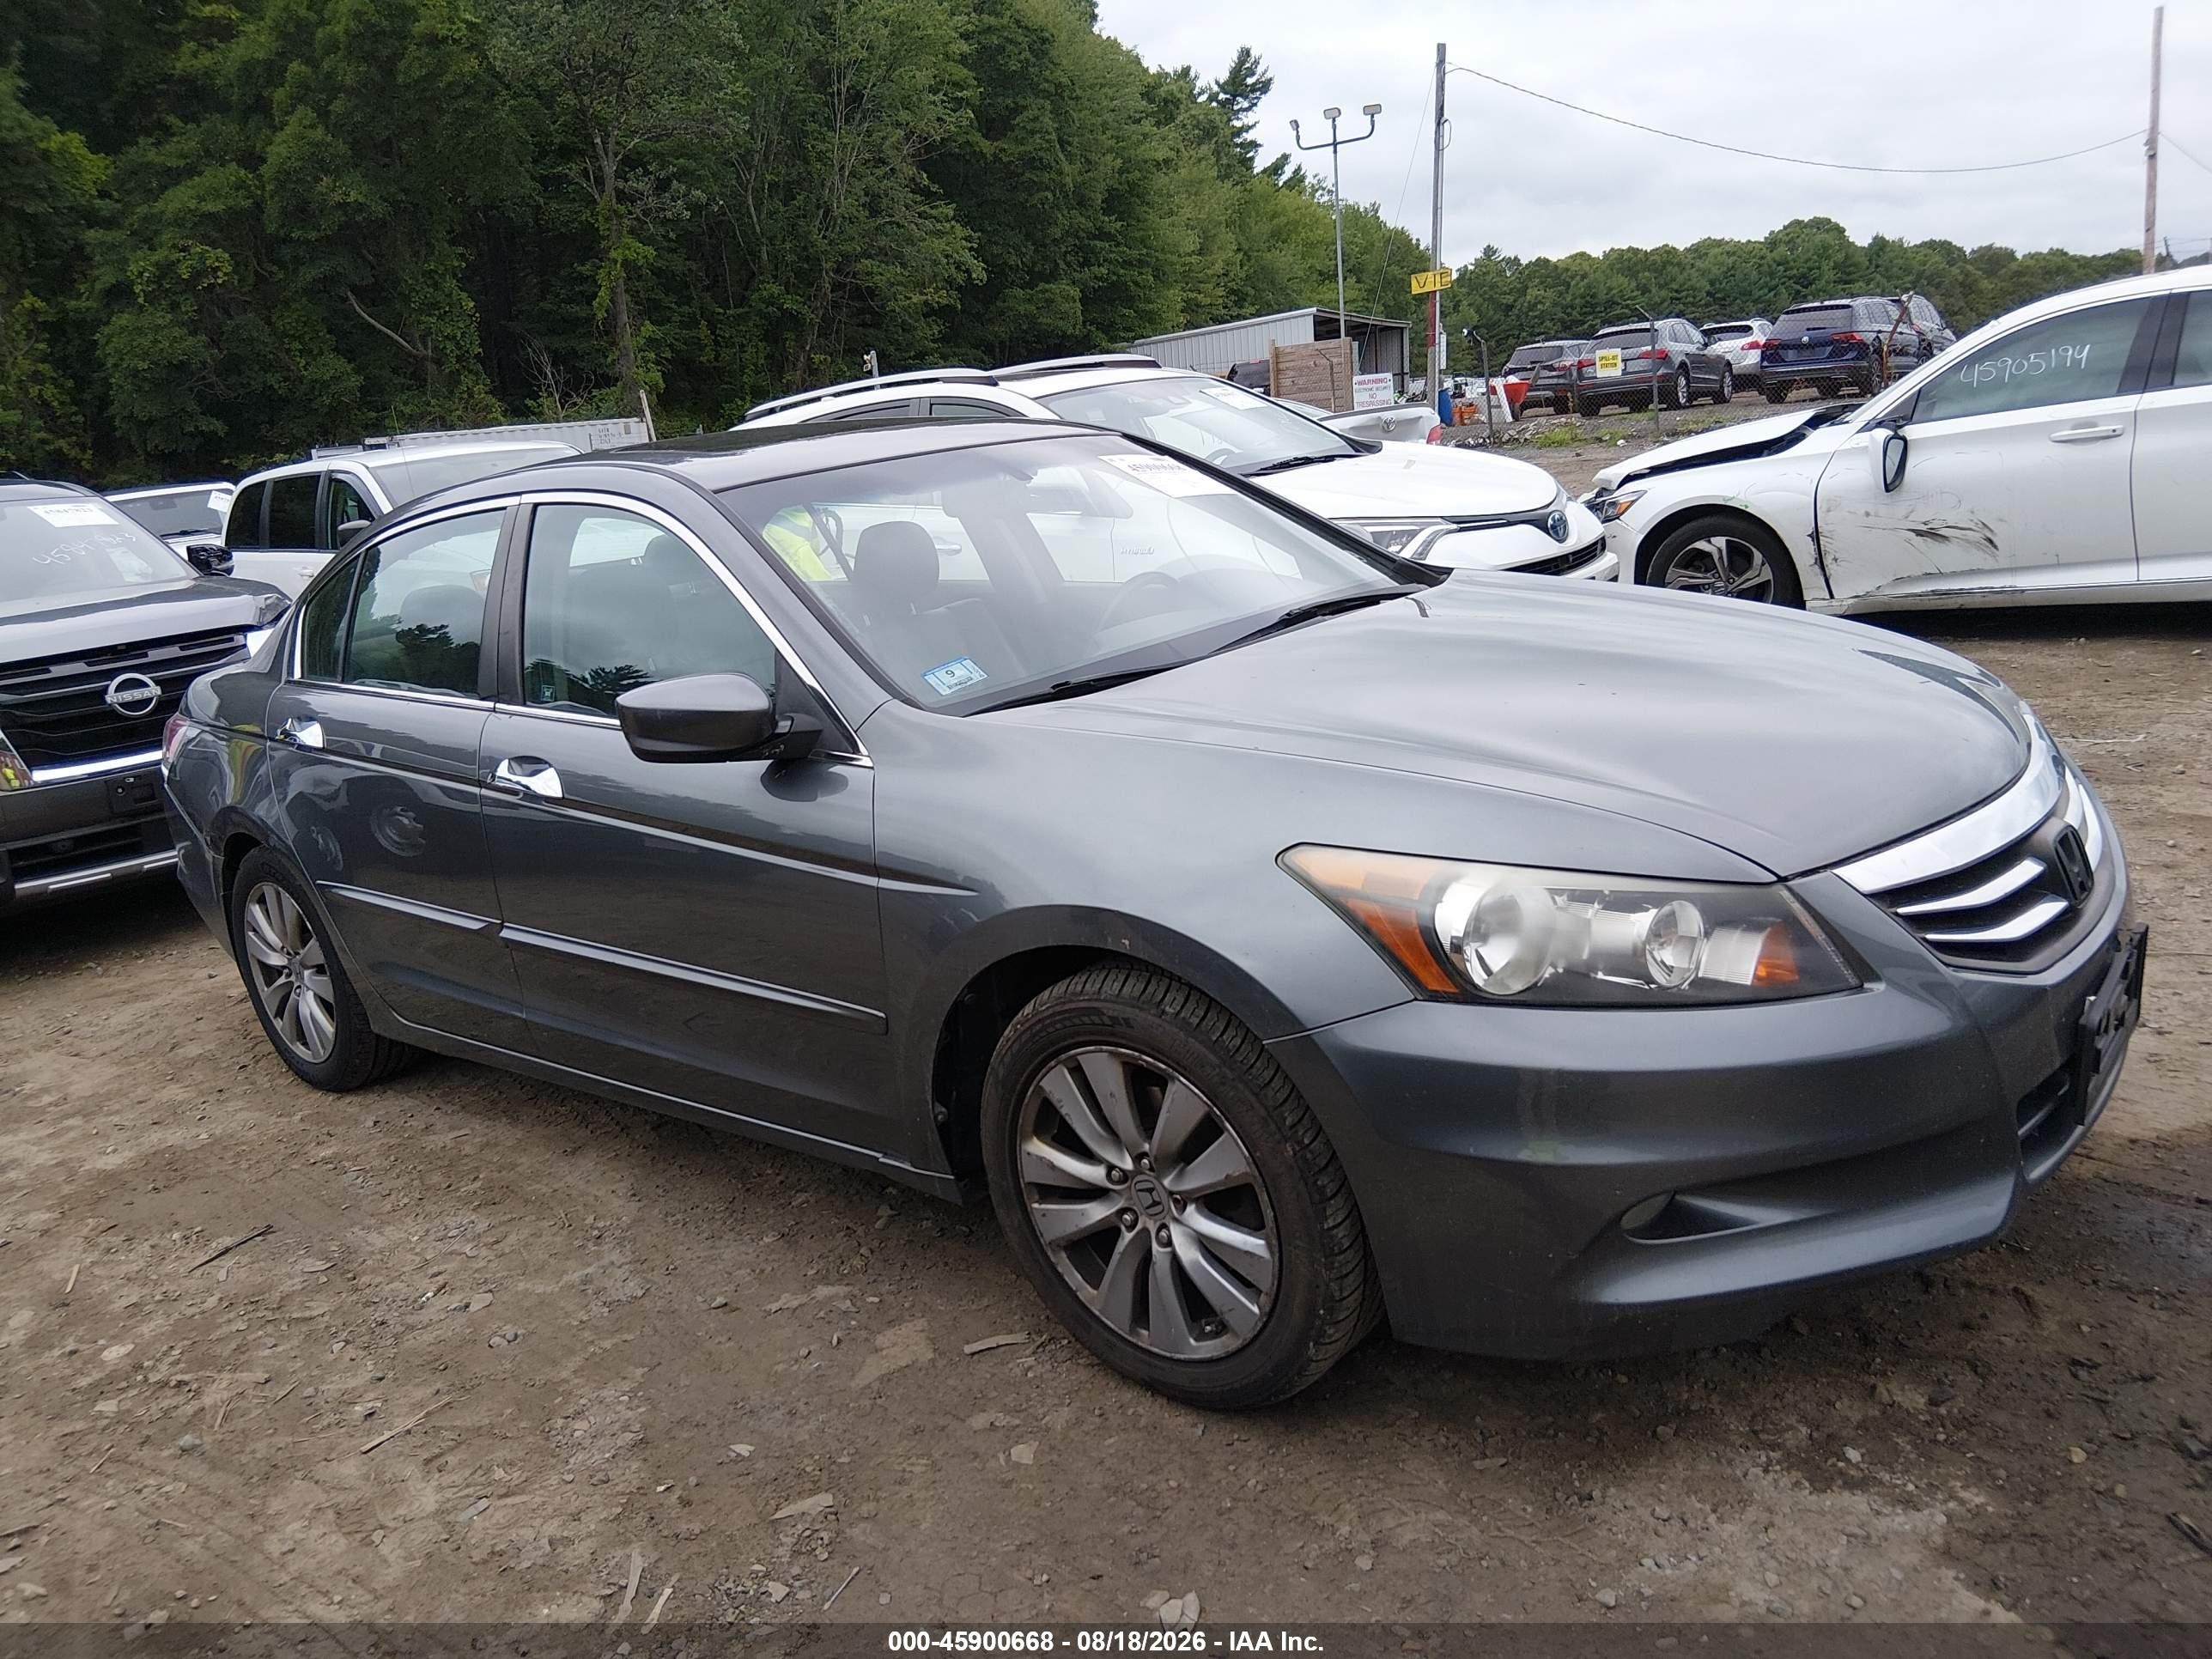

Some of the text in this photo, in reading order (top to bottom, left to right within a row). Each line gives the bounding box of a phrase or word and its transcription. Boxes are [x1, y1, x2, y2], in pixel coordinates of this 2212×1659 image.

[1960, 344, 2090, 387] 45905194
[1357, 377, 1388, 386] WARNING
[1355, 398, 1391, 408] TRESPASSING
[106, 688, 161, 702] NISSAN
